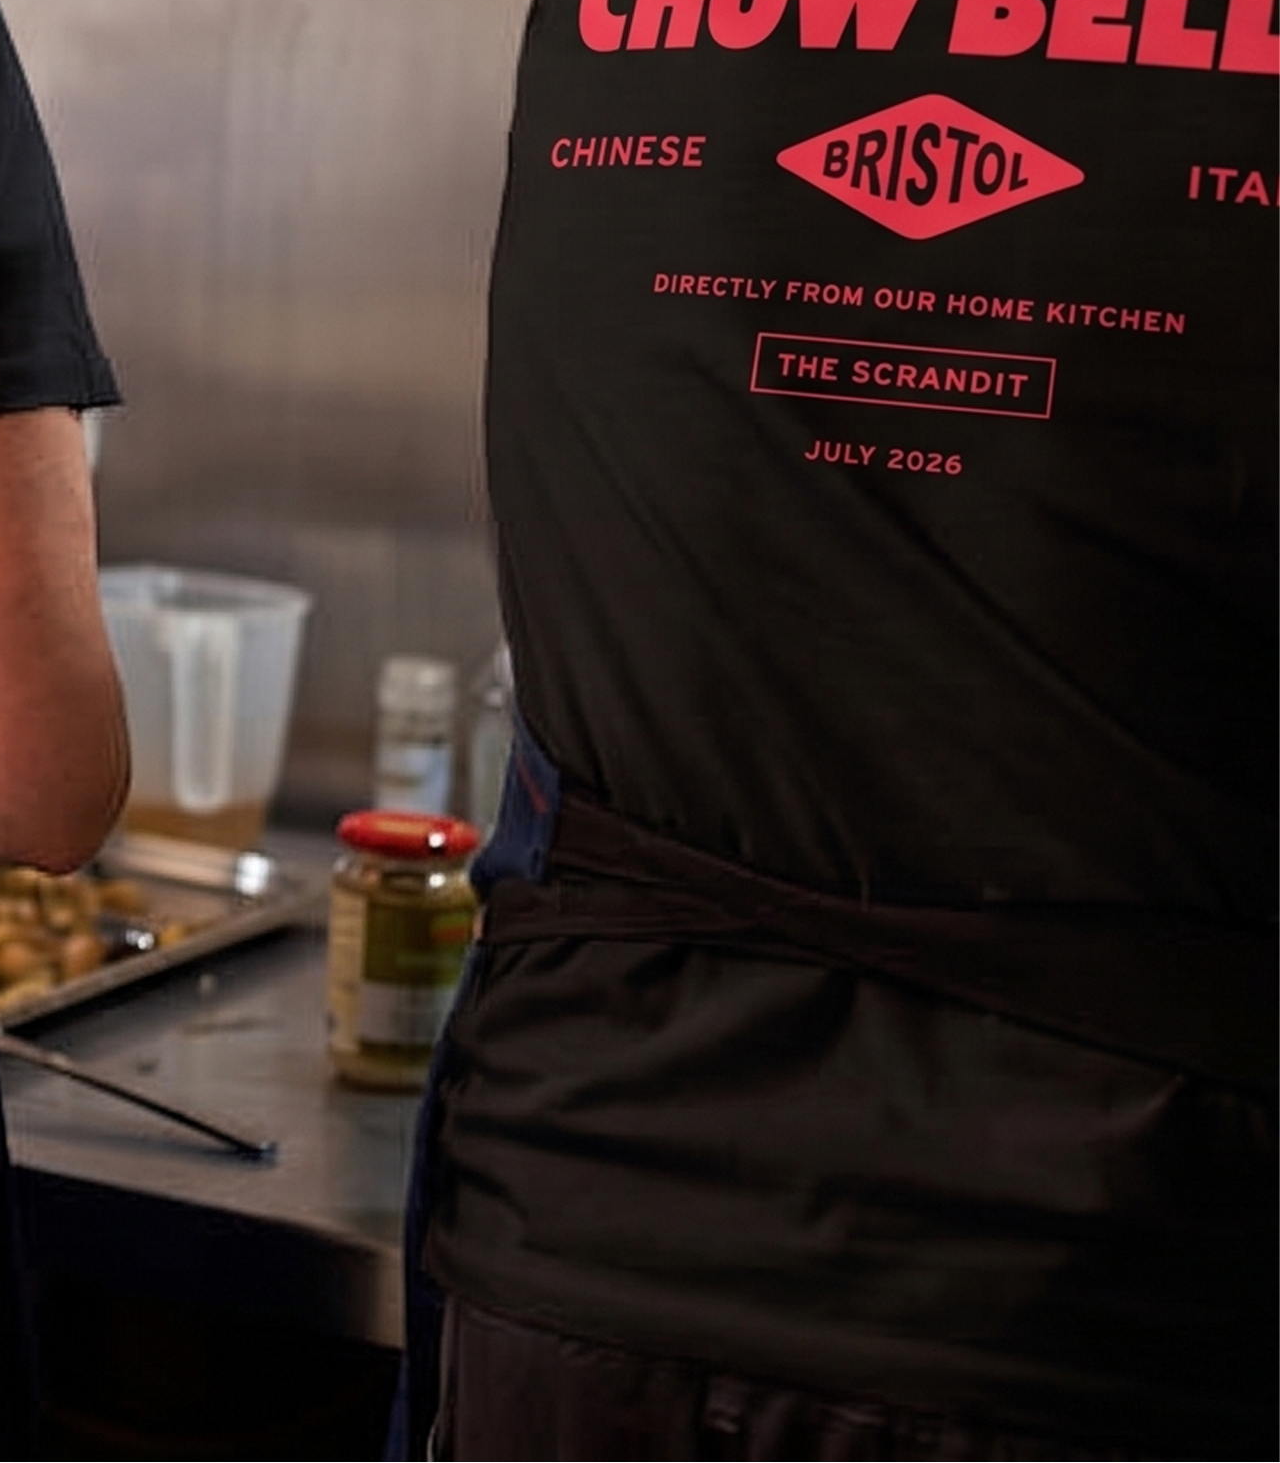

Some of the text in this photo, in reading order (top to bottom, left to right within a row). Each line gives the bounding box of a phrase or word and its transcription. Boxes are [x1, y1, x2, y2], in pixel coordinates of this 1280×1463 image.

[550, 135, 707, 170] CHINESE
[821, 120, 1031, 208] BRISTOL
[1187, 165, 1280, 208] ITA
[653, 272, 1186, 334] DIRECTLY FROM OUR HOME KITCHEN
[778, 352, 1030, 399] THE SCRANDIT
[805, 441, 963, 476] JULY 2026
